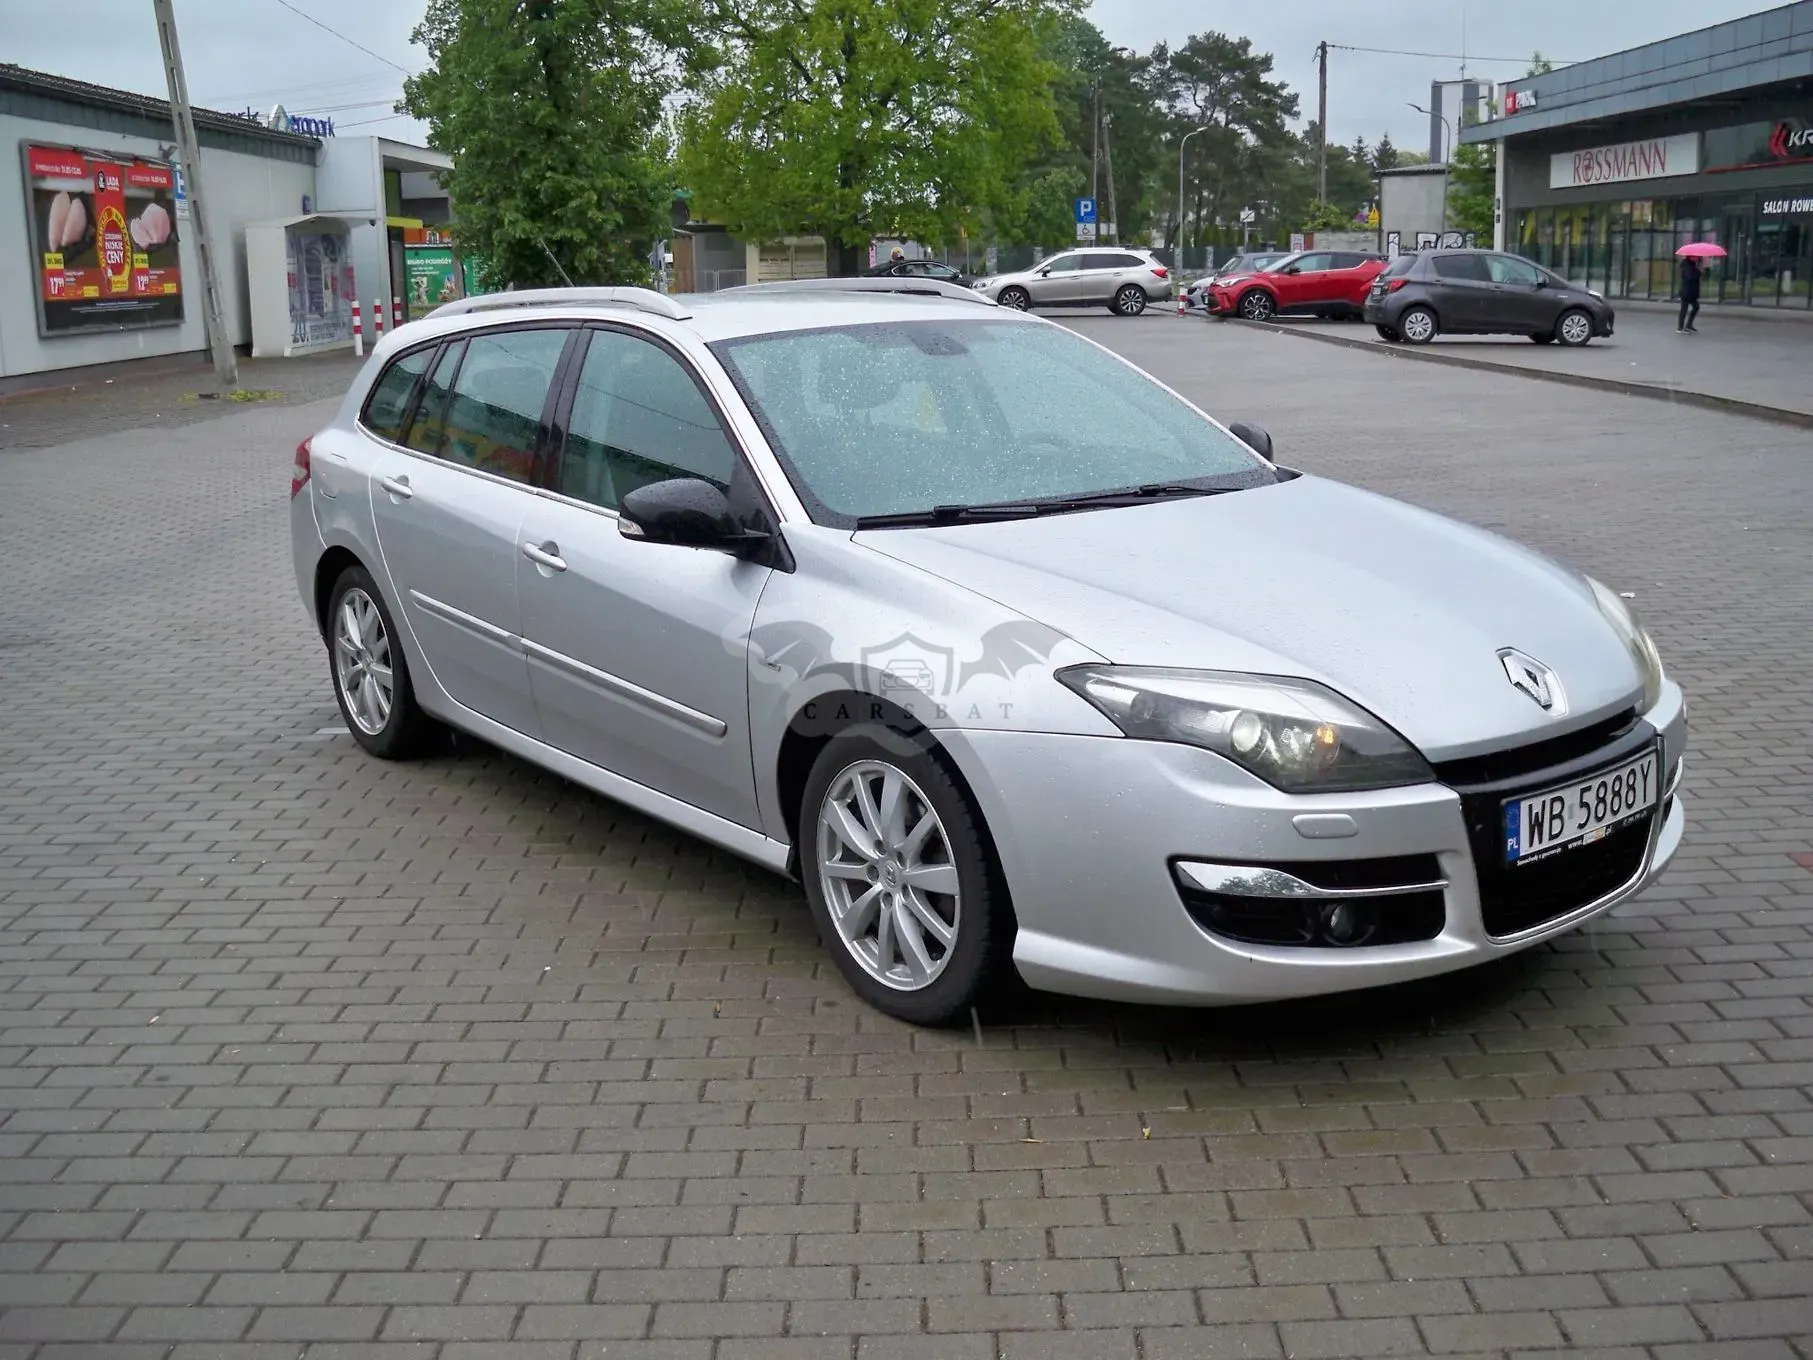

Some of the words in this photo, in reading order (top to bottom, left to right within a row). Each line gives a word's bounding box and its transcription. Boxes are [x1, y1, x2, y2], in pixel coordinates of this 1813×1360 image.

[1573, 140, 1667, 184] ROSSMANN
[1080, 200, 1092, 216] P
[1763, 201, 1788, 213] SALON
[106, 251, 124, 264] CENY
[1528, 795, 1565, 848] WB
[1576, 760, 1652, 830] 5888Y
[1507, 836, 1519, 851] PL
